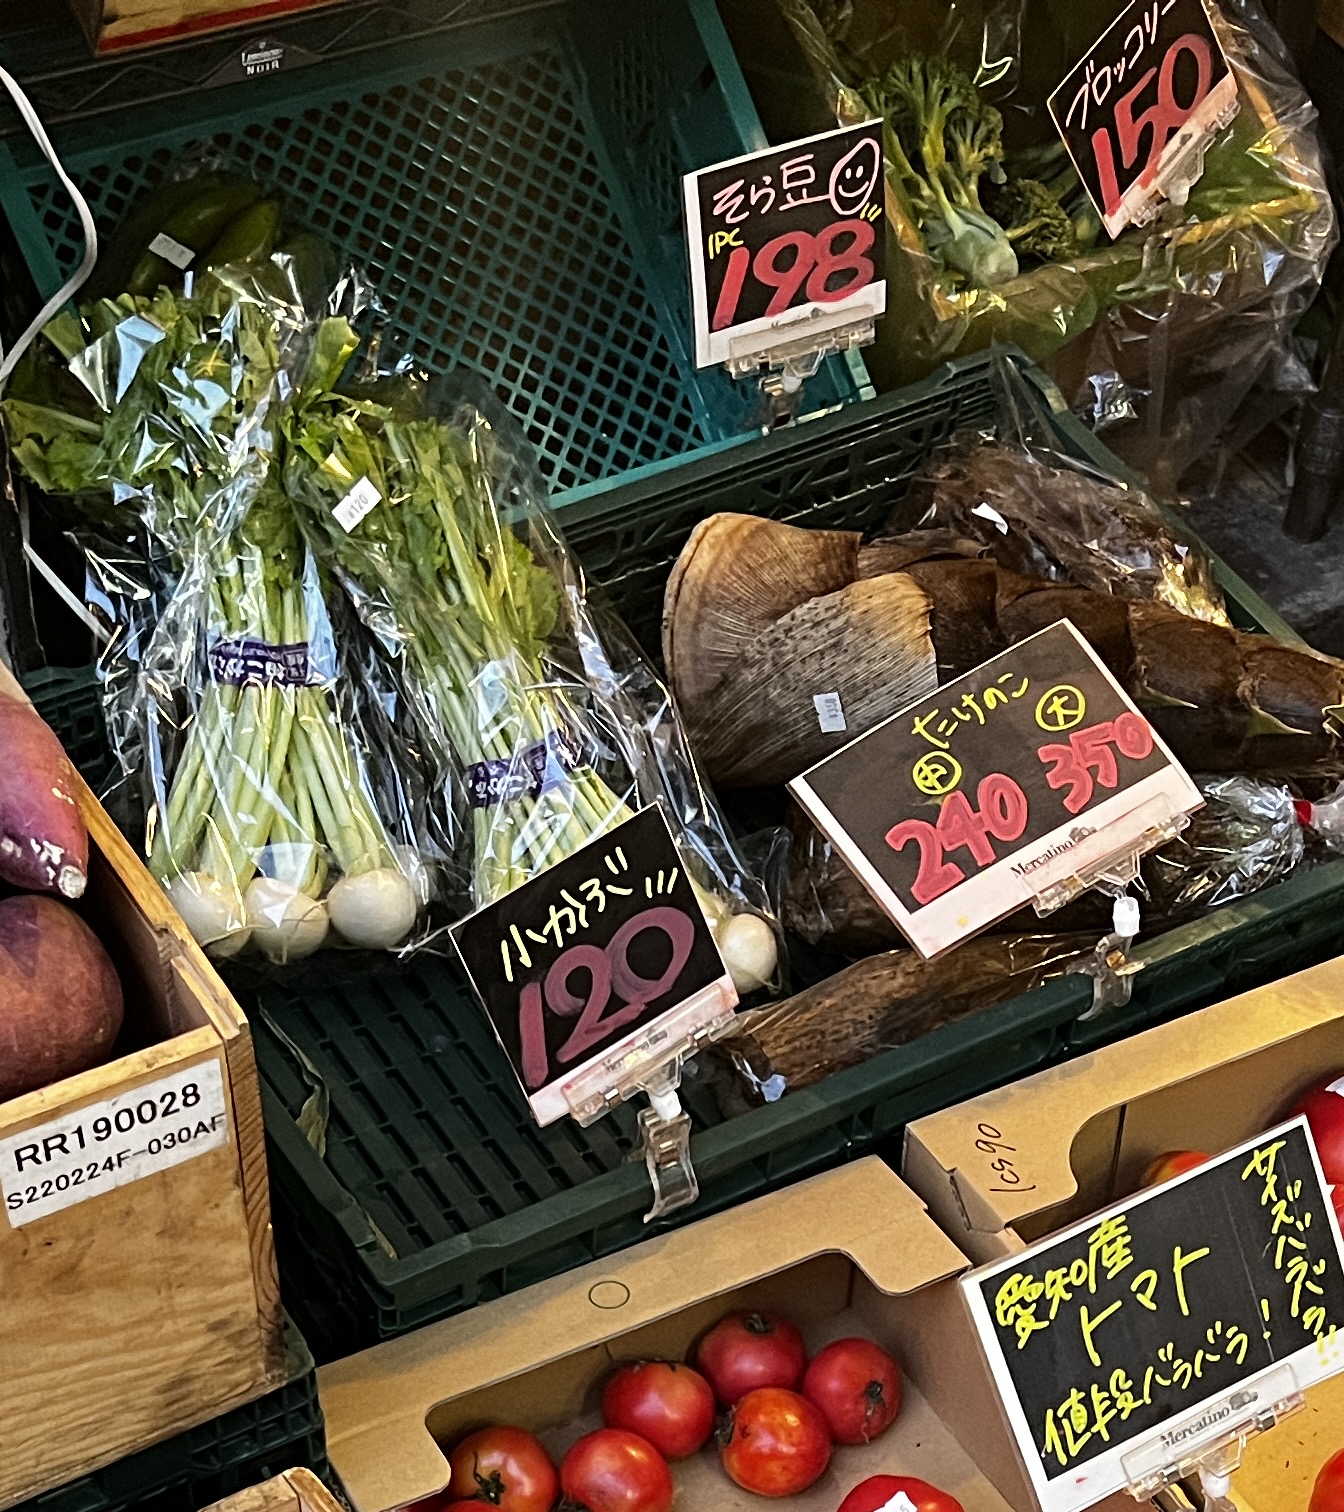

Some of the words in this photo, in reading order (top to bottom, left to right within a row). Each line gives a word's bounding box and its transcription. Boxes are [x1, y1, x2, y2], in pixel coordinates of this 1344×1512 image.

[1092, 33, 1213, 217] 150
[712, 153, 833, 224] そら豆
[711, 218, 876, 332] 198
[911, 672, 1030, 749] たけのこ
[1036, 711, 1154, 815] 350
[884, 771, 1029, 906] 240
[1008, 837, 1076, 880] Mercatino
[500, 846, 634, 983] 小かぶ
[518, 905, 696, 1090] 120
[6, 1112, 226, 1211] S220224F-030AF
[13, 1082, 202, 1173] RR190028
[995, 1215, 1134, 1349] 愛知産
[1080, 1245, 1211, 1367] トマト
[1160, 1406, 1231, 1448] Mercatino
